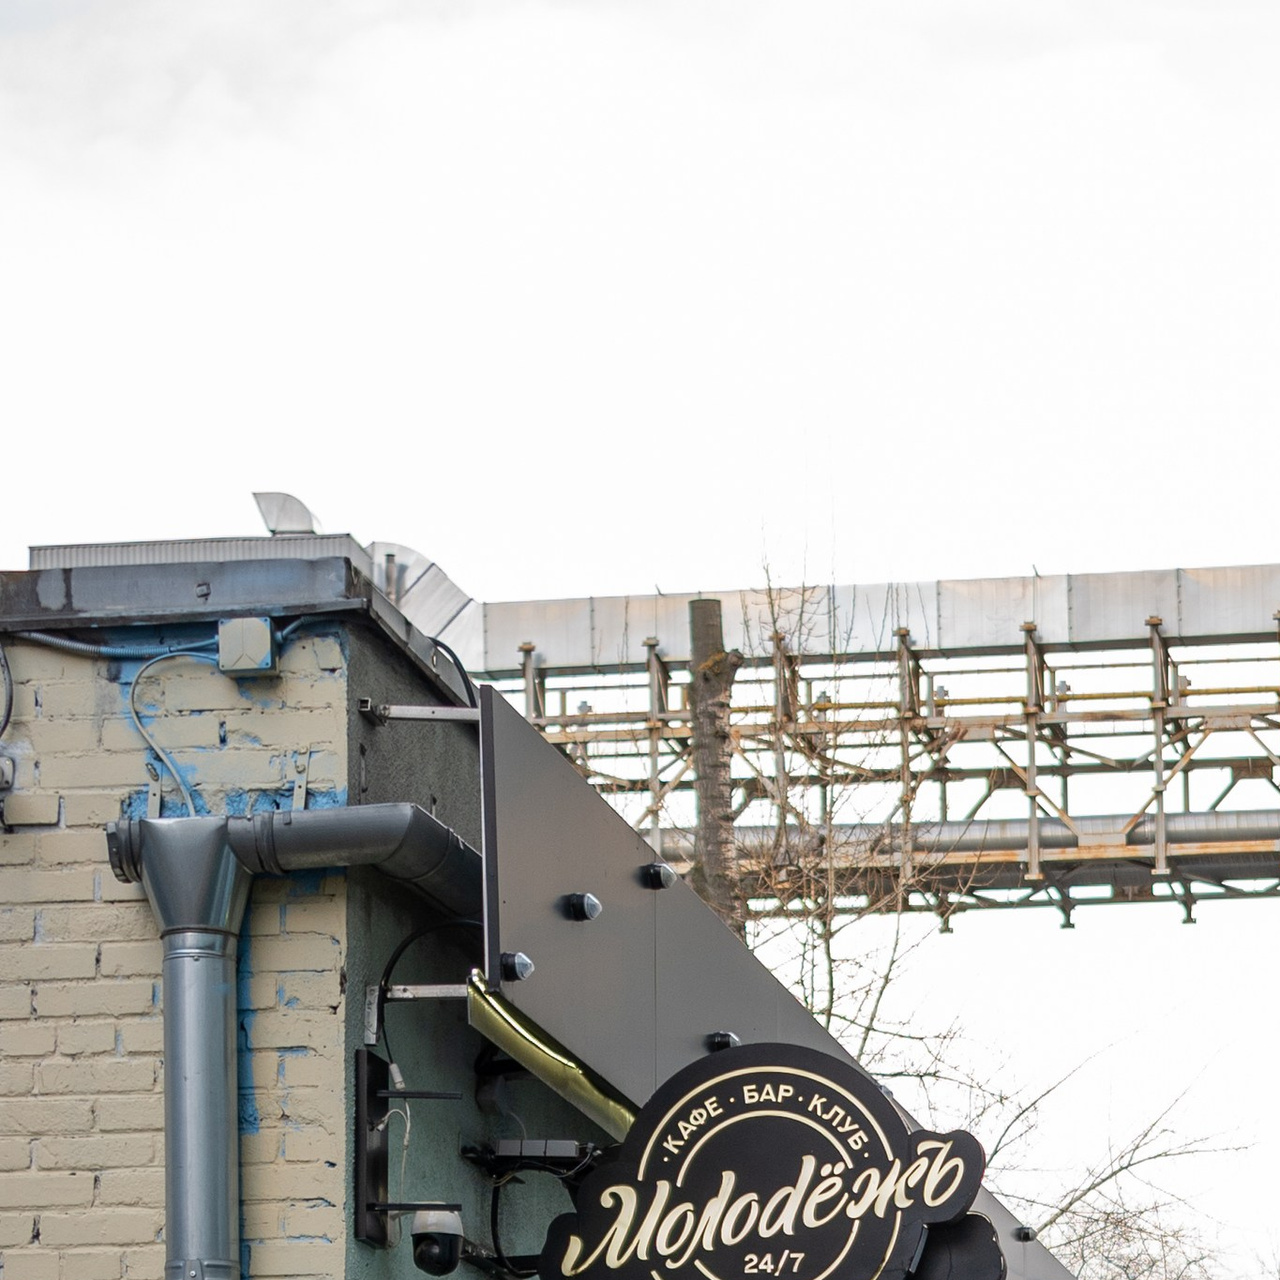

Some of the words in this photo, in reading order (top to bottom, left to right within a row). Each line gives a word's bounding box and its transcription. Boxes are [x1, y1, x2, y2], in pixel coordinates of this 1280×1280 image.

[662, 1096, 724, 1155] КАФЕ
[743, 1083, 795, 1105] БАР
[807, 1093, 871, 1151] КЛУБ
[743, 1249, 805, 1276] 24/7
